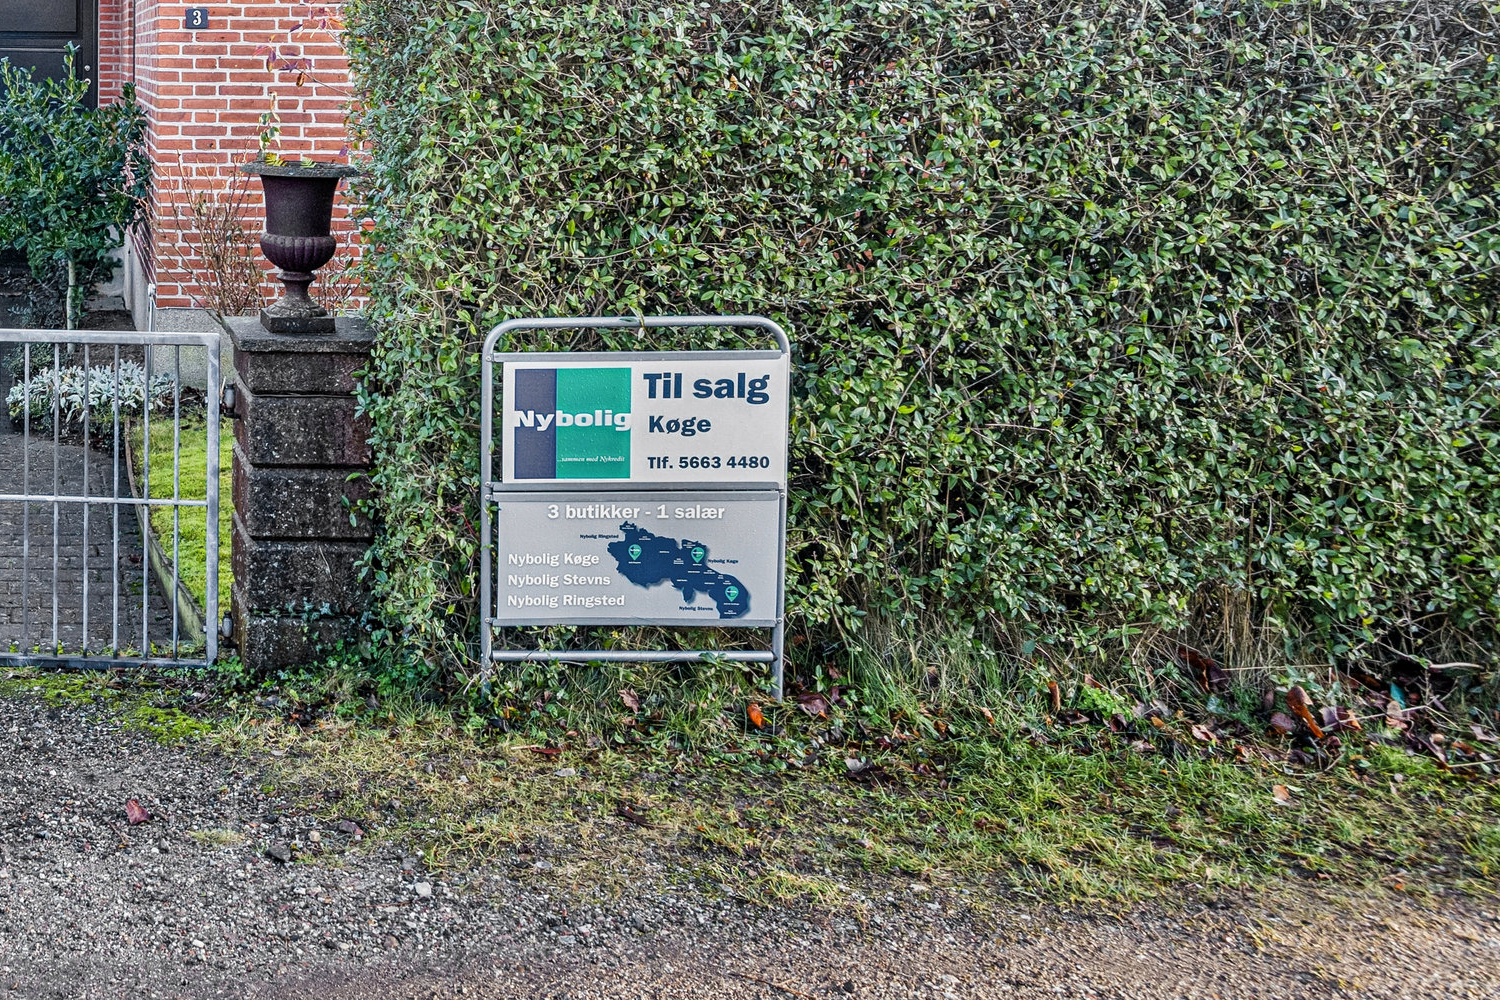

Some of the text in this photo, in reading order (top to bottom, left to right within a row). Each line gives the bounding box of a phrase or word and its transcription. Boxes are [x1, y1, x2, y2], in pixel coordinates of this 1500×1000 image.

[192, 10, 202, 26] 3
[643, 372, 770, 405] Til salg
[514, 410, 631, 432] Nybolig
[648, 415, 712, 437] Køge
[647, 456, 770, 469] Tlf. 5663 4480
[547, 504, 559, 519] 3
[565, 504, 641, 519] butikker
[656, 504, 669, 519] 1
[674, 504, 725, 519] salær
[508, 553, 600, 567] Nybolig Køge
[508, 573, 611, 588] Nybolig Stevns
[507, 594, 625, 608] Nybolig Ringsted
